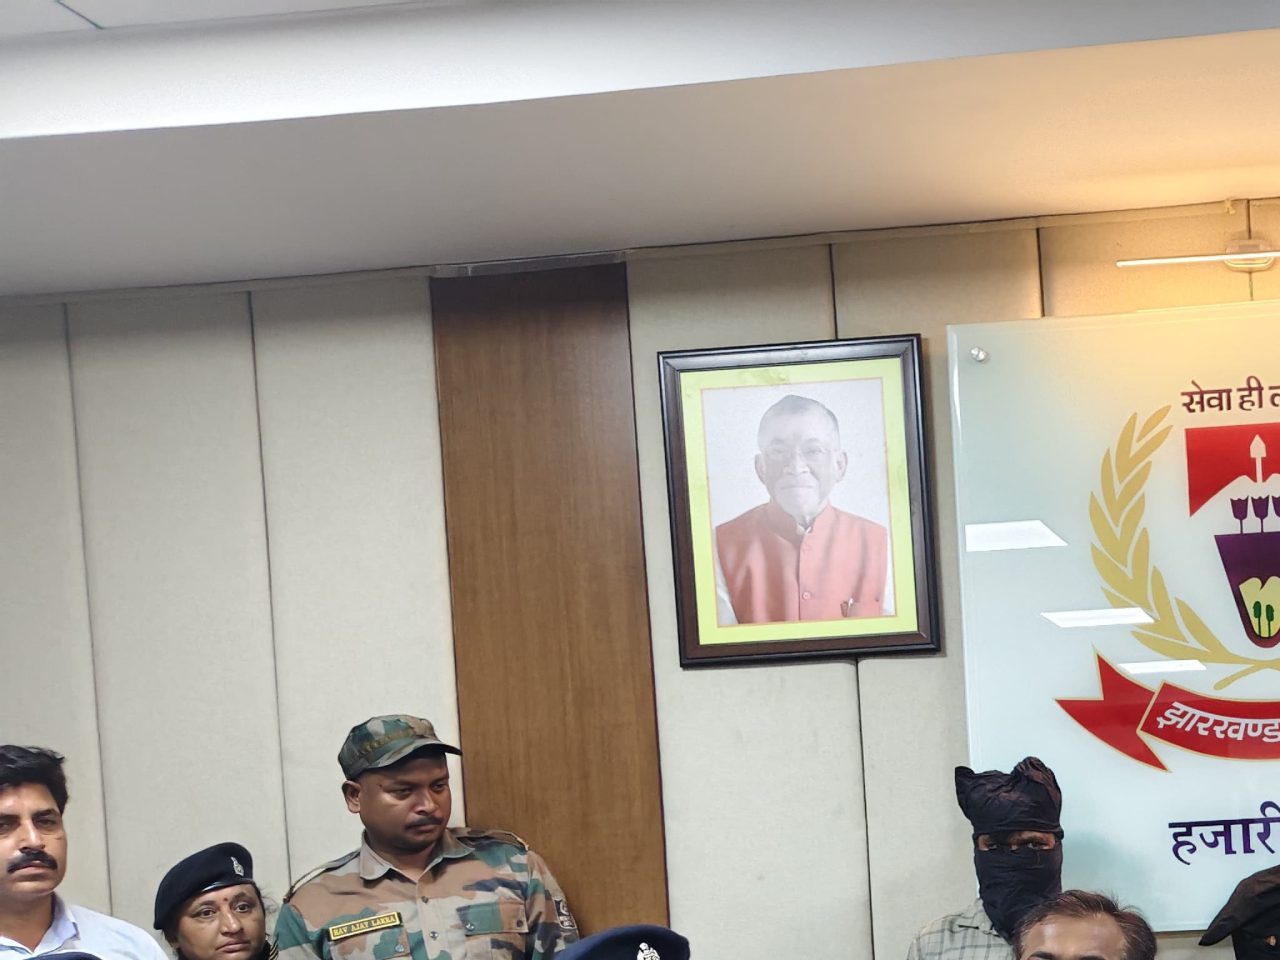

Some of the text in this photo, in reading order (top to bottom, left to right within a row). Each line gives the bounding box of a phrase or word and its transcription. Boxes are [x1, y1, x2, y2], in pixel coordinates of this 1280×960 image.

[1181, 380, 1232, 413] सेवा
[1238, 375, 1264, 410] ही
[351, 921, 370, 932] AJAY
[371, 915, 396, 927] LAKRA
